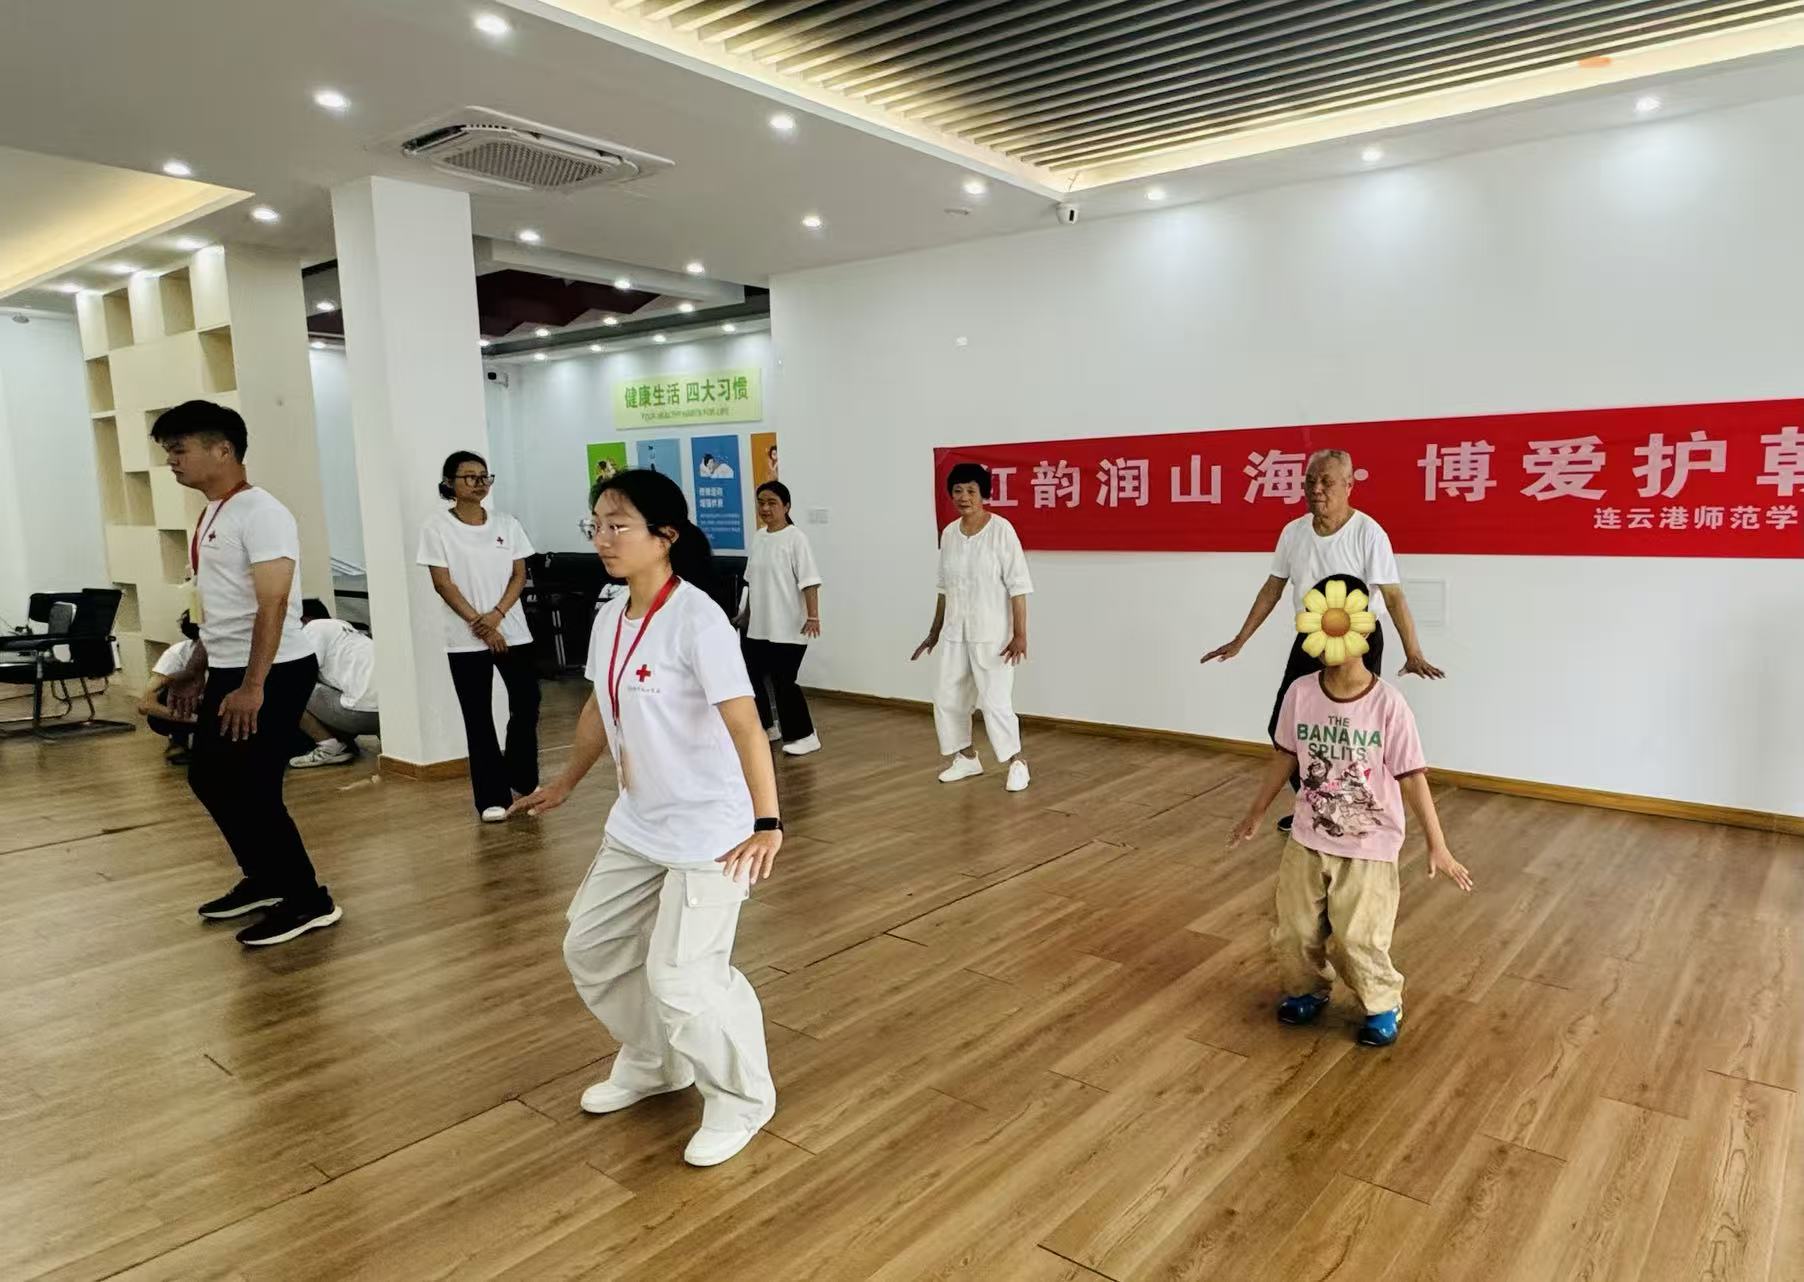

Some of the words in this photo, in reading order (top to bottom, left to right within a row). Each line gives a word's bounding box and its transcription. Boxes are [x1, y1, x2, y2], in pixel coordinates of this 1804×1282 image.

[625, 383, 680, 408] 健康生活
[686, 376, 748, 402] 四大习惯
[1593, 504, 1798, 530] 连云港师范学
[1328, 715, 1350, 727] THE
[1297, 723, 1382, 748] BANANA
[1308, 742, 1367, 763] SPLITS
